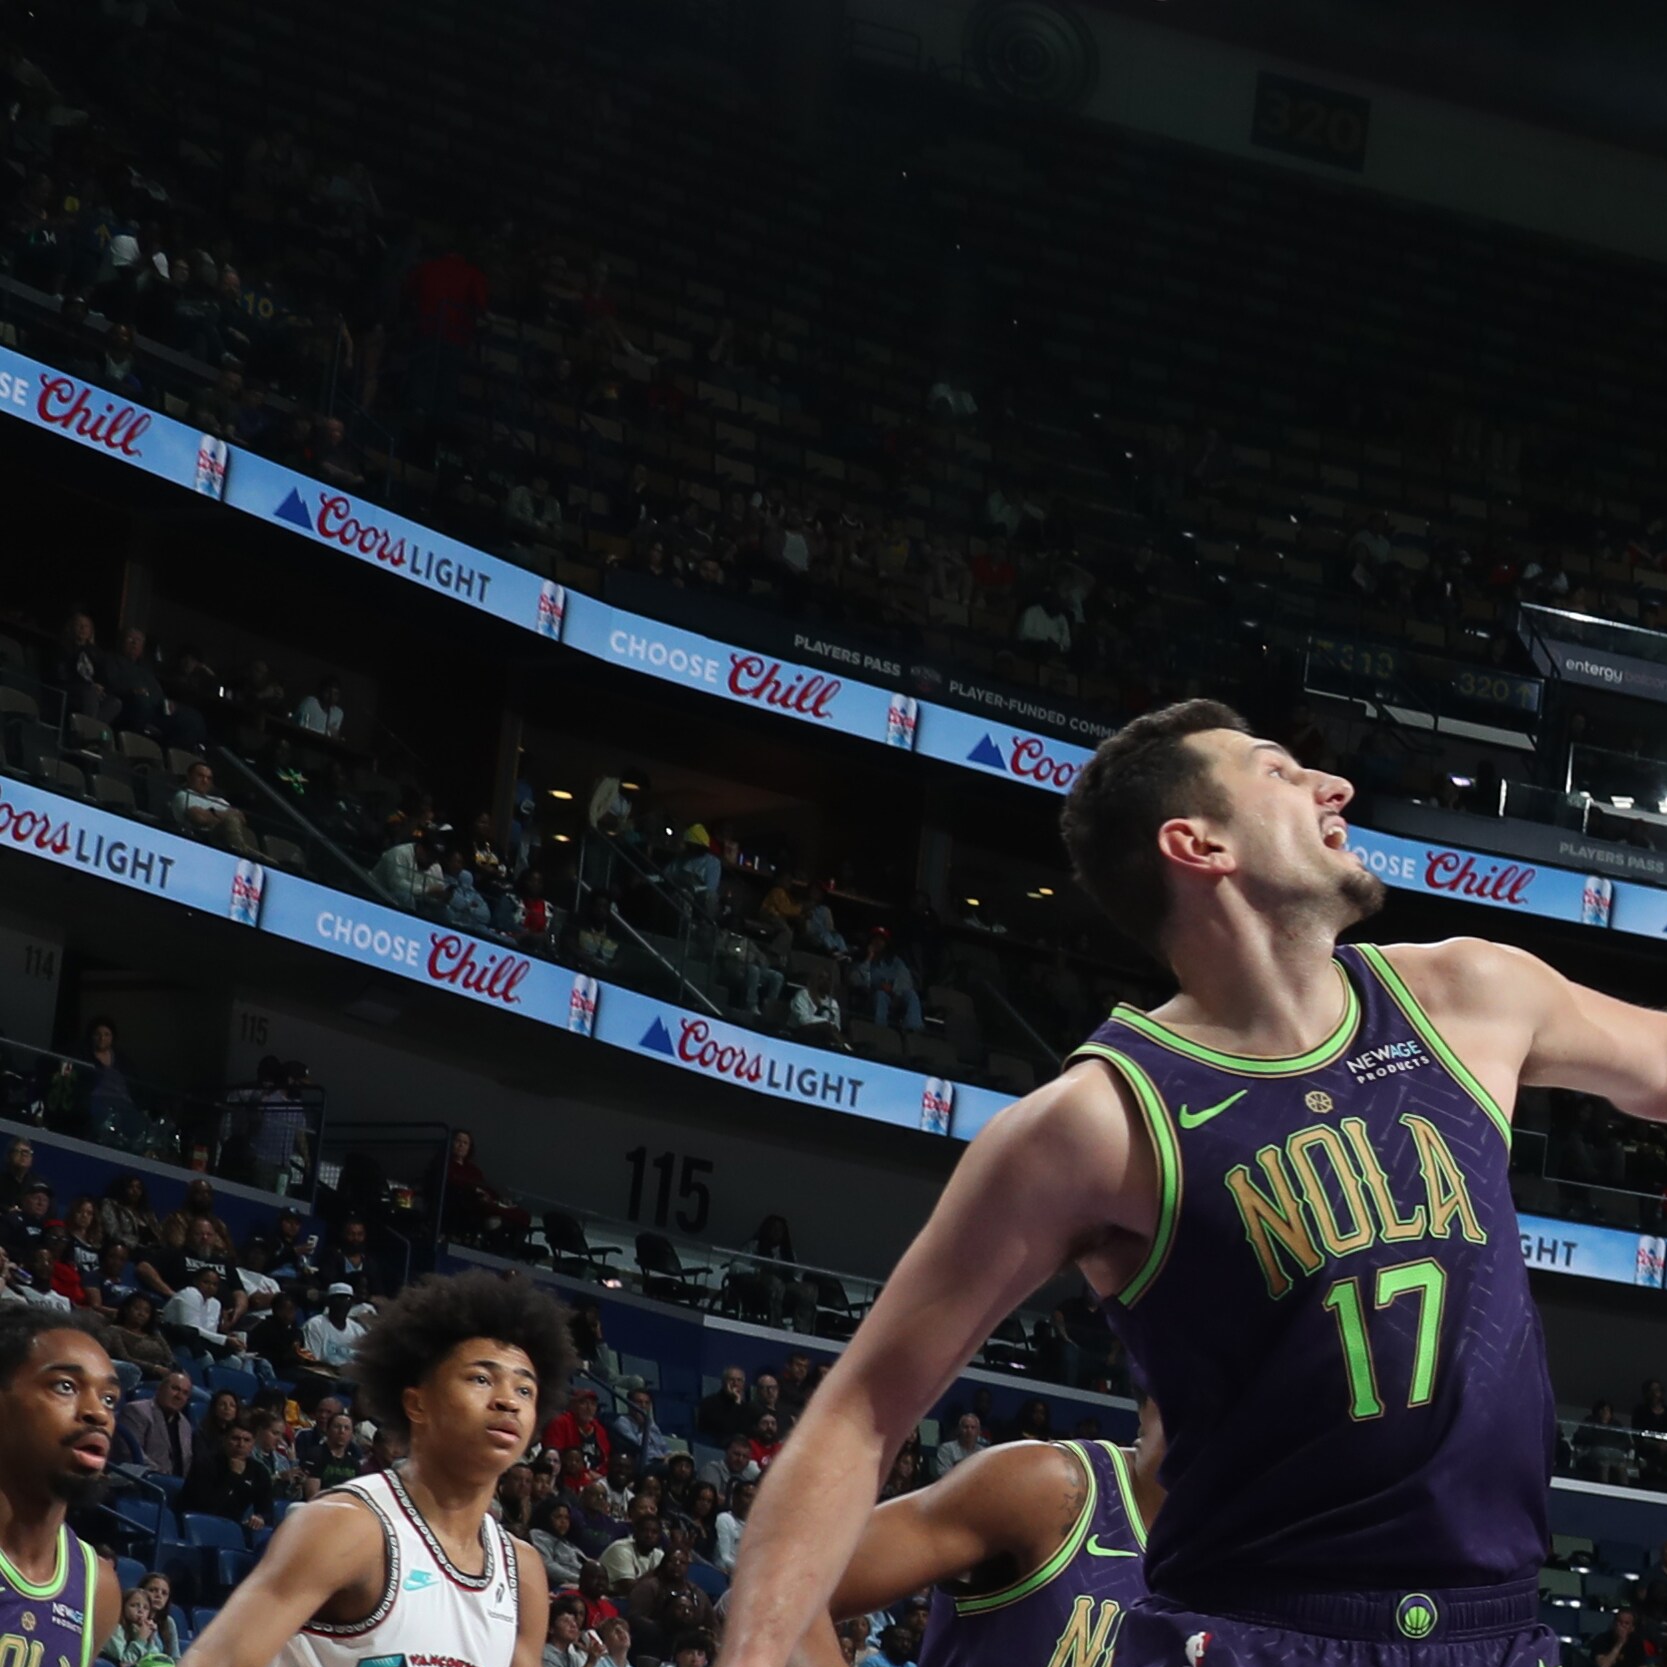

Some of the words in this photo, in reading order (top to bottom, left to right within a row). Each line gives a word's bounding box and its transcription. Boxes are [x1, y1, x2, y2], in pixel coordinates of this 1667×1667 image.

[37, 373, 152, 457] Chill
[317, 491, 407, 567] Coors
[410, 545, 492, 603] LIGHT
[609, 630, 720, 684] CHOOSE
[728, 653, 841, 720] Chill
[794, 634, 861, 667] PLAYERS
[862, 653, 902, 678] PASS
[1565, 656, 1624, 684] entergy
[949, 679, 1067, 727] PLAYER-FUNDED
[1010, 736, 1083, 787] Coo
[0, 802, 71, 855] oors
[75, 828, 175, 889] LIGHT
[1348, 846, 1416, 880] OOSE
[1425, 850, 1537, 905] Chill
[1559, 841, 1626, 870] PLAYERS
[1626, 854, 1666, 875] PASS
[316, 911, 421, 968] CHOOSE
[427, 931, 531, 1004] Chill
[240, 1012, 269, 1048] 115
[678, 1016, 762, 1084] Coors
[766, 1059, 865, 1108] LIGHT
[1356, 1055, 1430, 1084] PRODUCTS
[625, 1146, 714, 1235] 115
[1224, 1112, 1489, 1299] NOLA
[1519, 1237, 1578, 1267] GHT
[1322, 1257, 1447, 1422] 17
